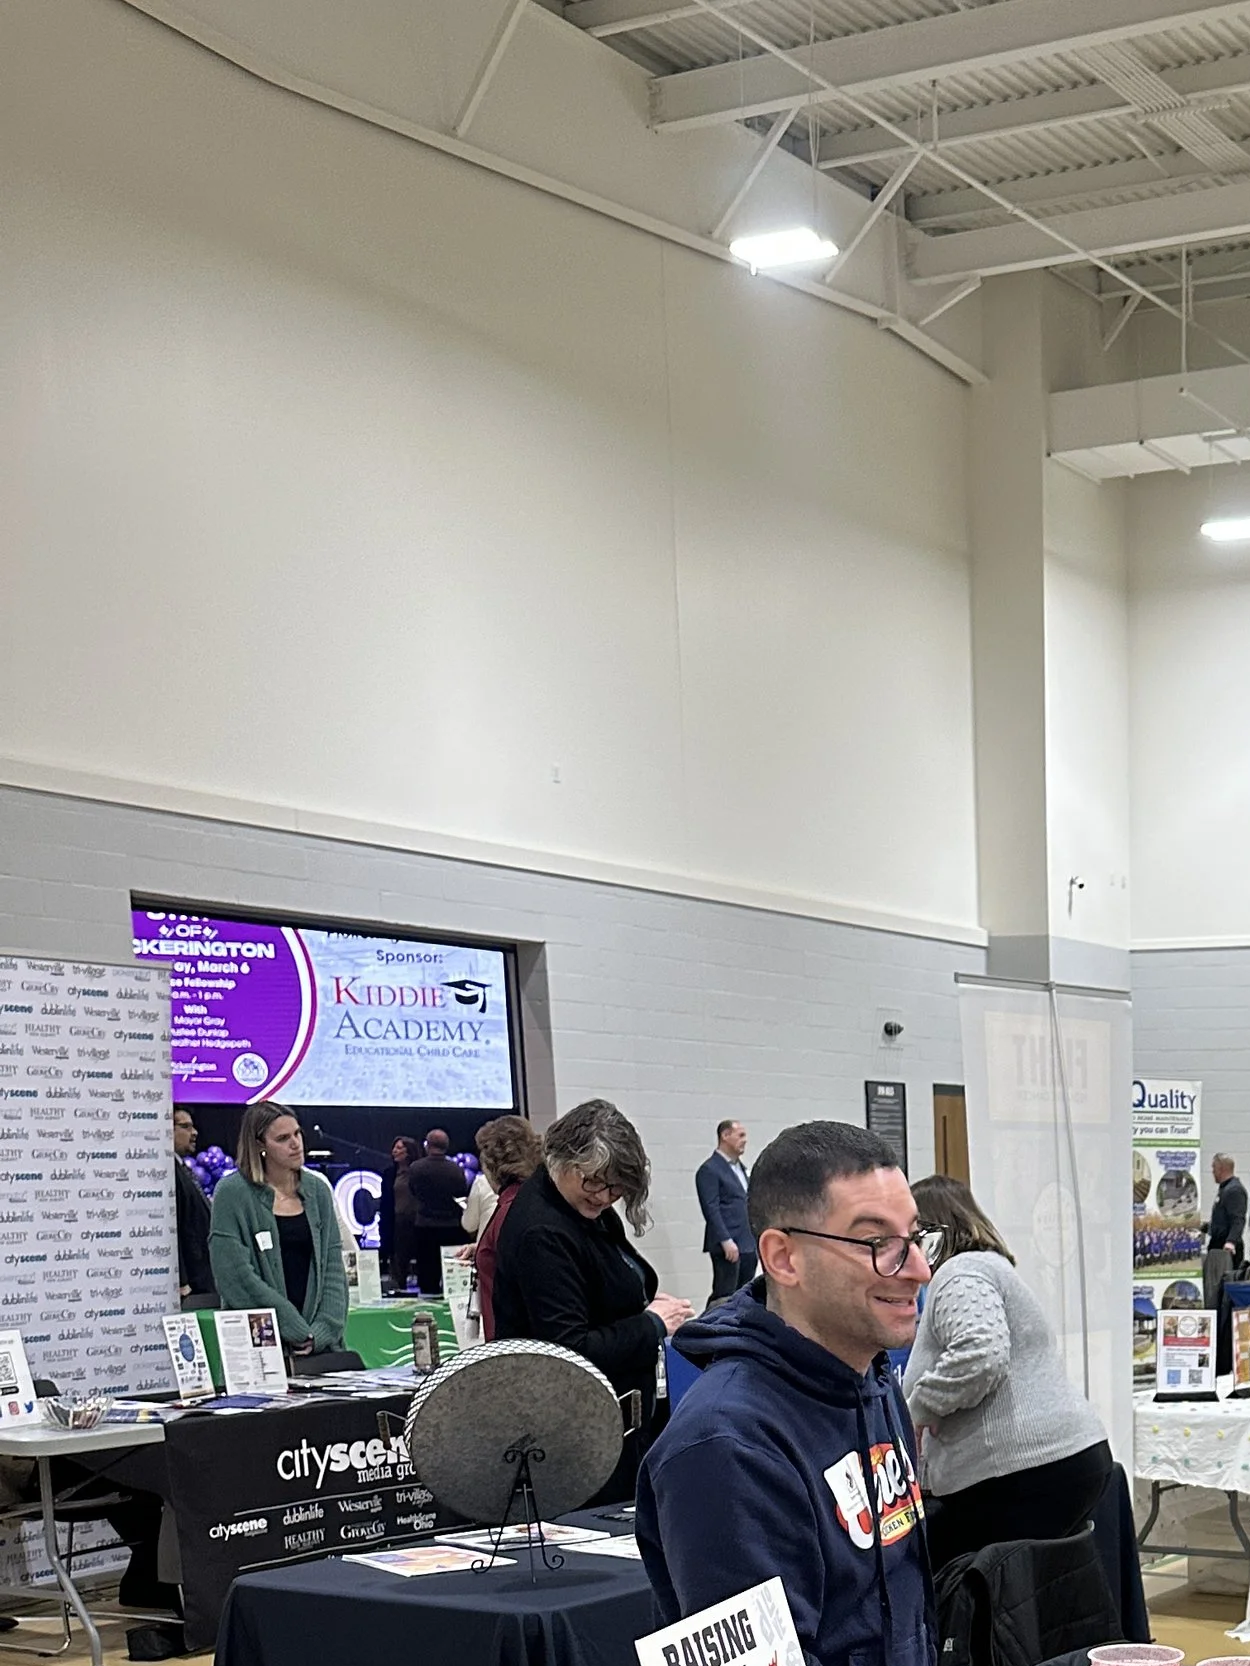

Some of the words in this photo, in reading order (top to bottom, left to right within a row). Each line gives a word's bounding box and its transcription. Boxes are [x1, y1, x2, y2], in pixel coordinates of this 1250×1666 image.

[175, 924, 202, 938] OF
[377, 949, 444, 965] Sponsor:
[197, 960, 239, 974] March
[240, 961, 251, 974] 6
[1140, 1126, 1154, 1135] you
[1155, 1125, 1169, 1134] can
[357, 1464, 393, 1484] media
[282, 1502, 325, 1525] dublinlife
[209, 1517, 268, 1542] cityscene
[414, 1519, 434, 1531] Ohio
[284, 1528, 326, 1550] HEALTHY
